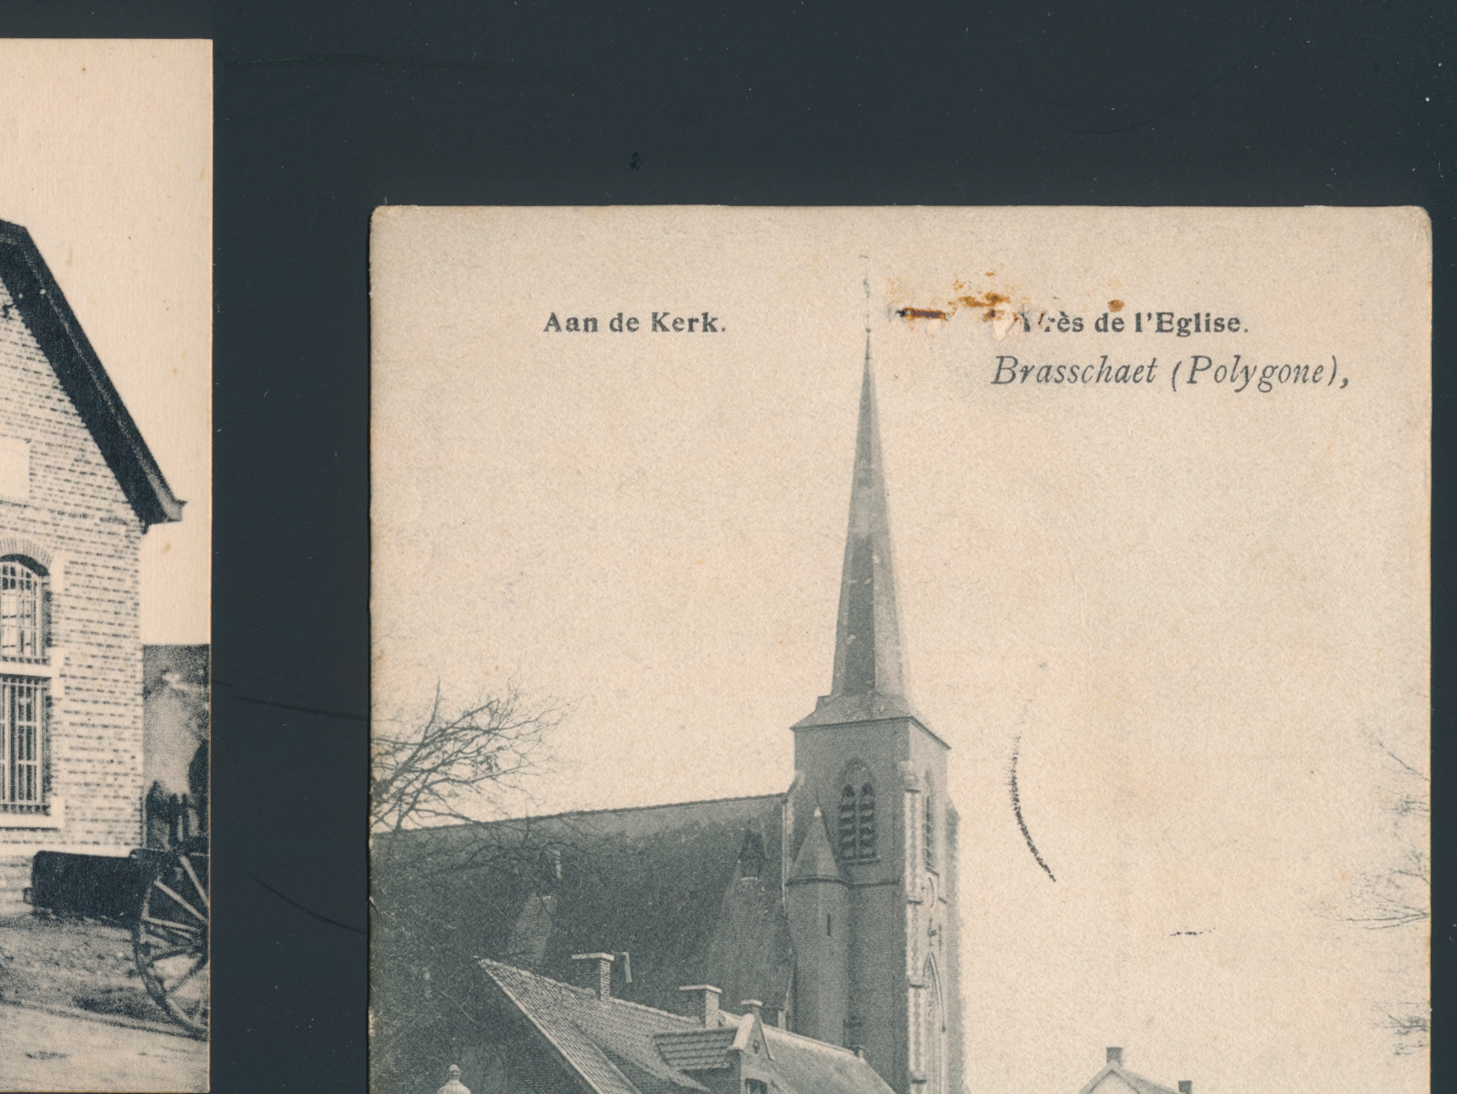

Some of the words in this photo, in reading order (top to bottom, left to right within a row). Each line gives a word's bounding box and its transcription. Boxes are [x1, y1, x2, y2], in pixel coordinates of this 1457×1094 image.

[543, 311, 599, 333] Aan
[608, 311, 640, 333] de
[651, 311, 726, 333] Kerk.
[1021, 310, 1085, 333] rès
[1094, 311, 1125, 333] de
[1134, 311, 1249, 338] l'Eglise.
[990, 354, 1159, 385] Brasschaet
[1171, 354, 1349, 394] (Polygone),
